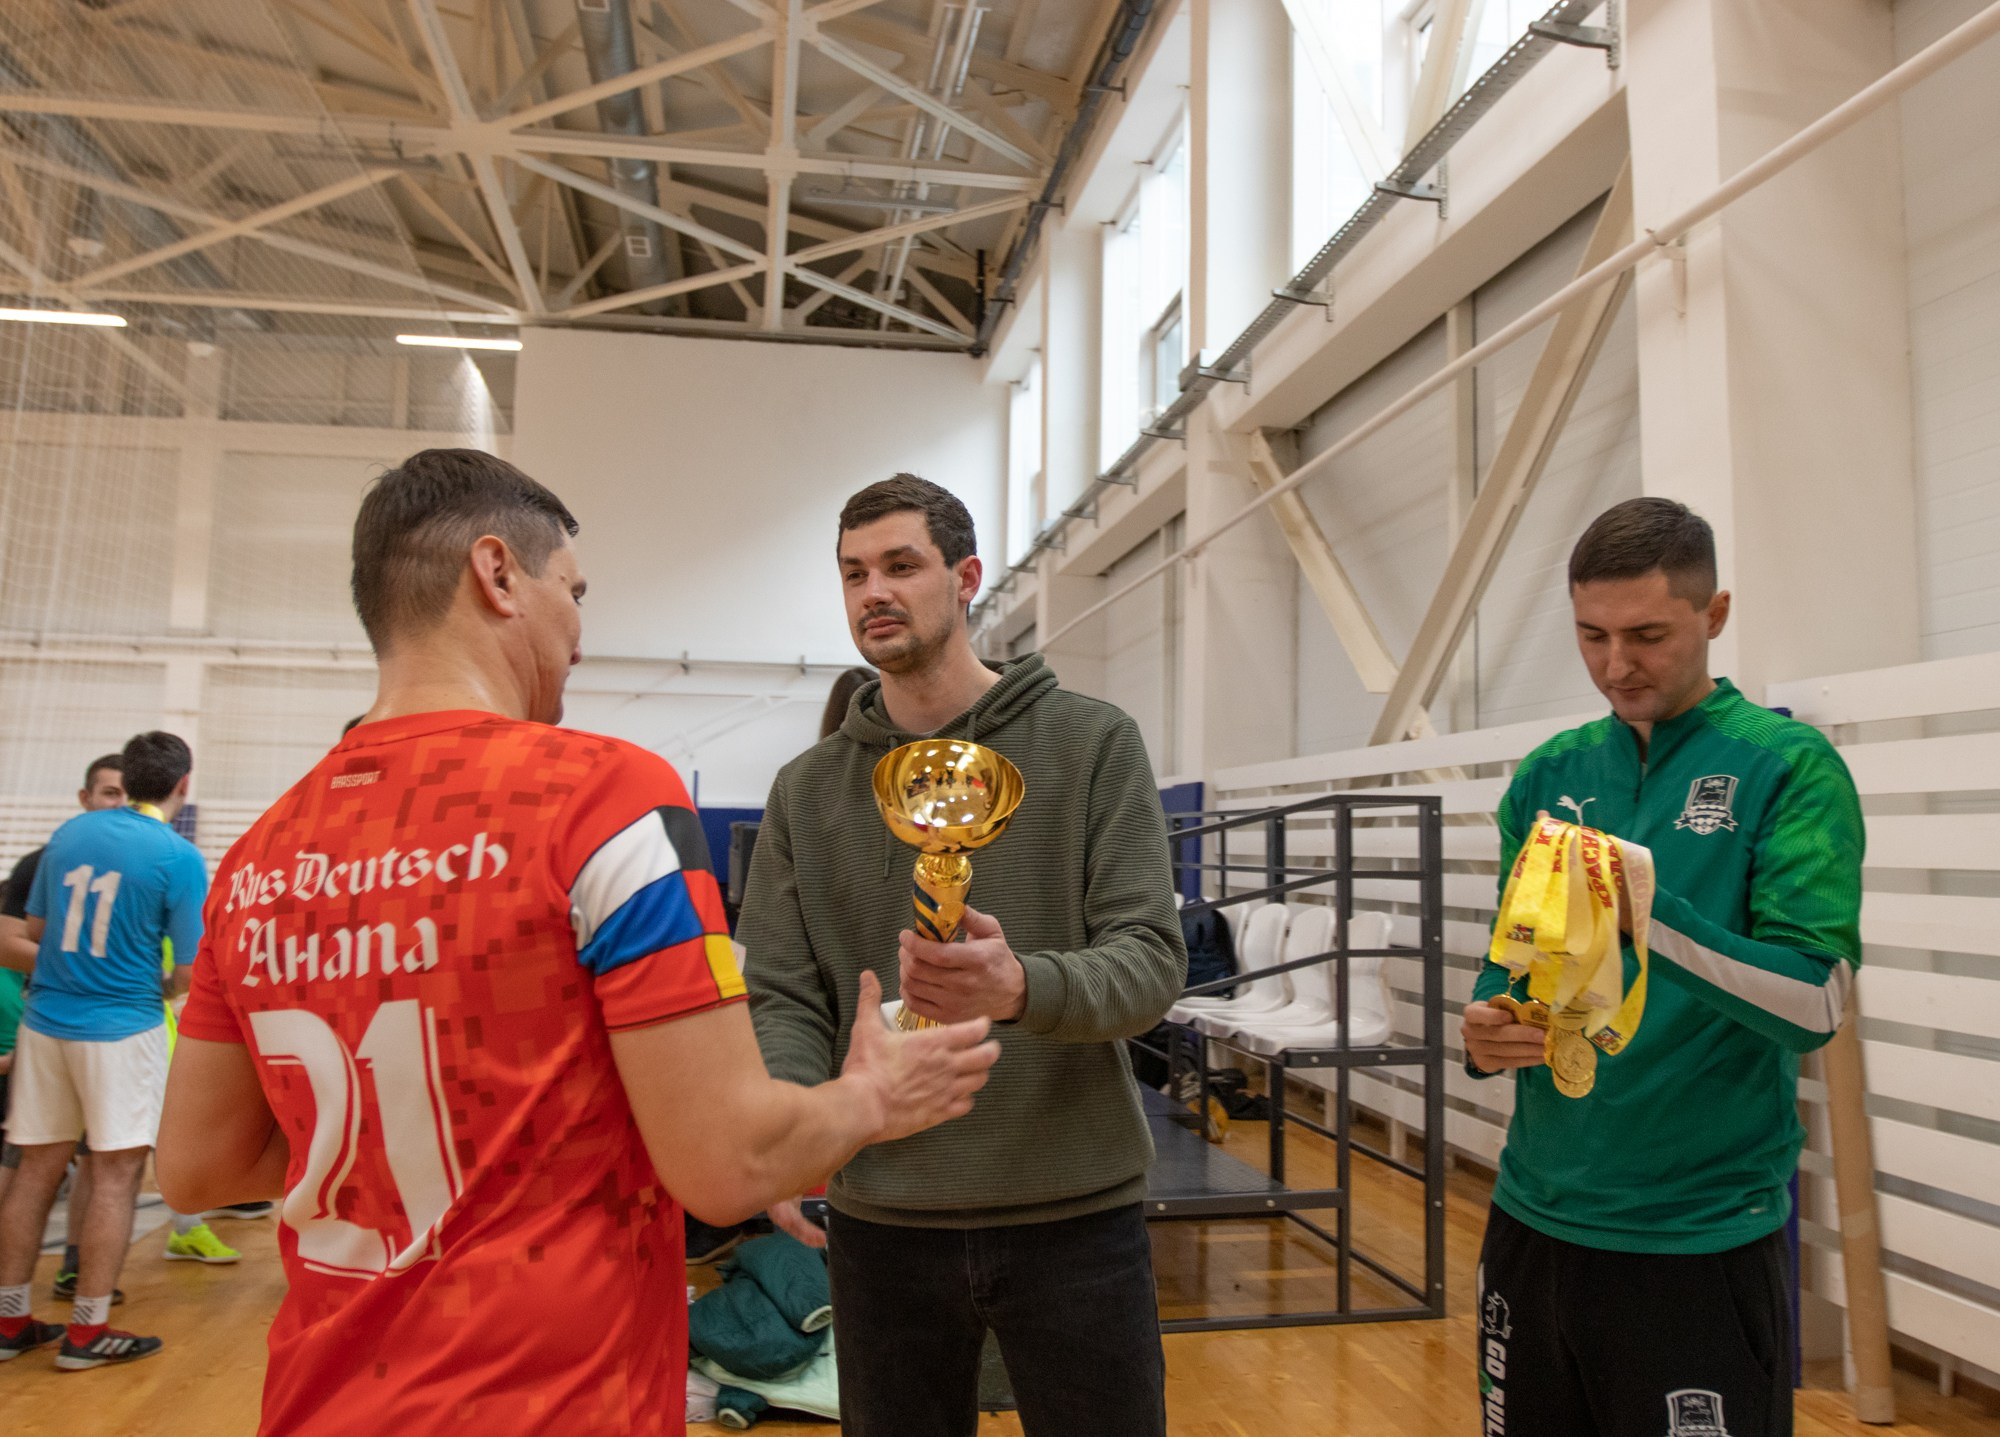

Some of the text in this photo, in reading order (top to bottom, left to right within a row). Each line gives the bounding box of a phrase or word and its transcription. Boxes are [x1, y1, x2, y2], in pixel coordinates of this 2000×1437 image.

[60, 864, 122, 958] 11
[291, 832, 509, 902] Deutsch
[238, 917, 439, 987] Анапа
[249, 998, 463, 1281] 21
[1484, 1338, 1507, 1437] GO BUL
